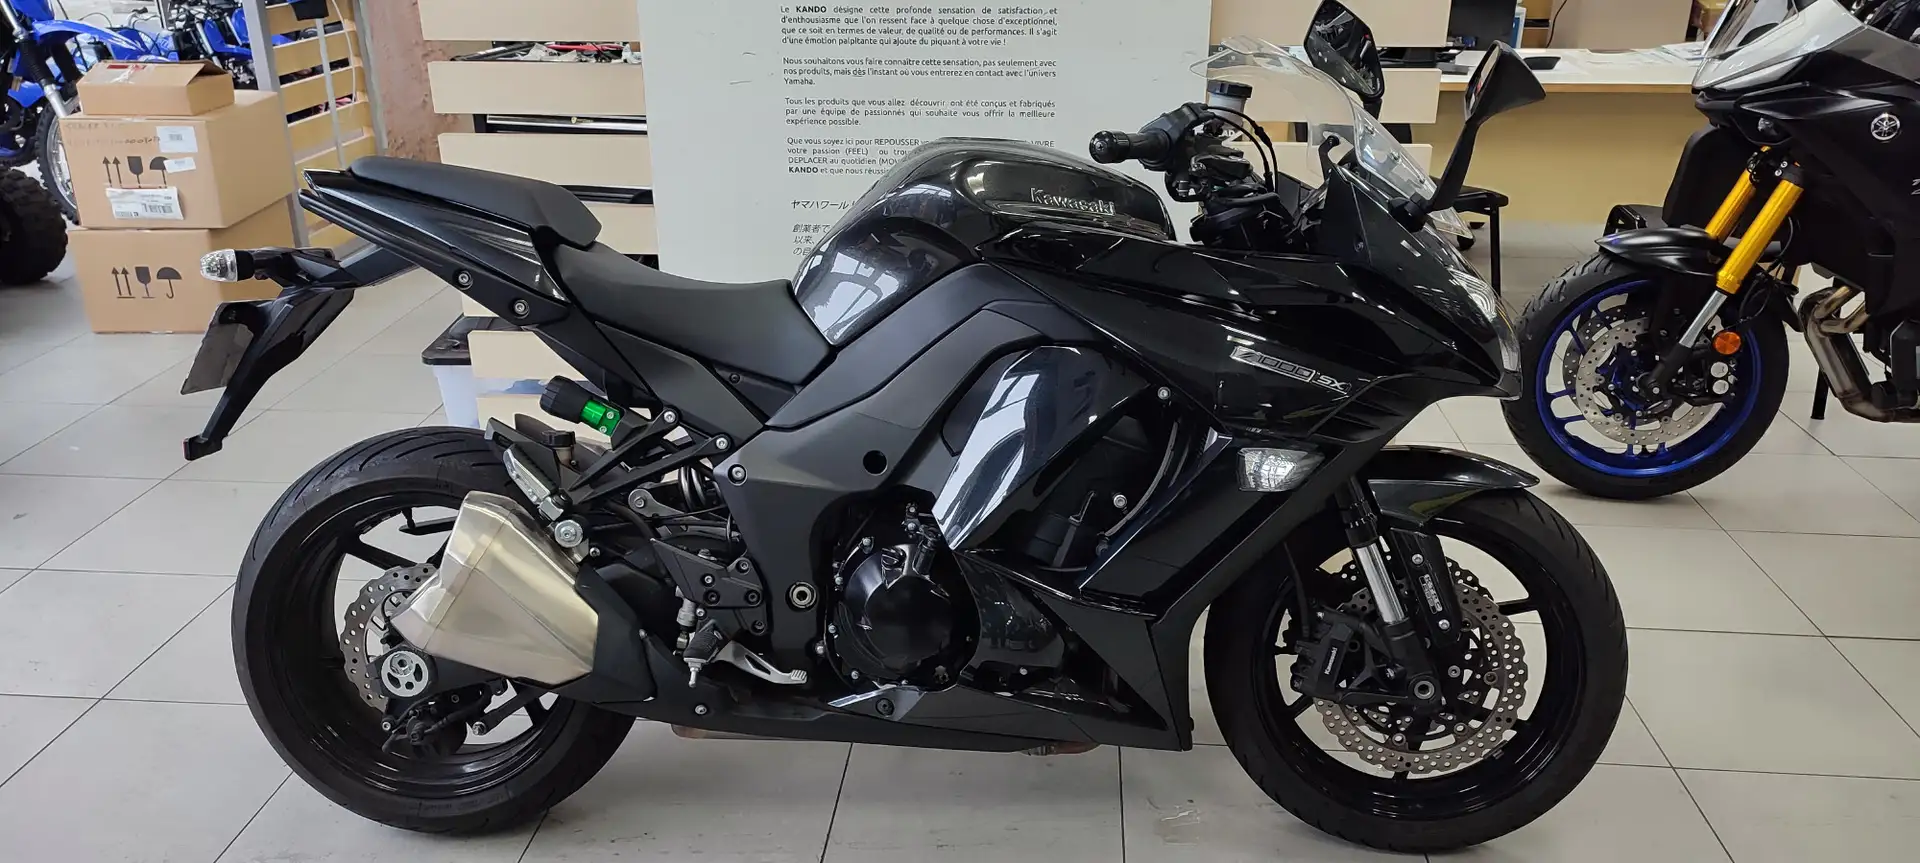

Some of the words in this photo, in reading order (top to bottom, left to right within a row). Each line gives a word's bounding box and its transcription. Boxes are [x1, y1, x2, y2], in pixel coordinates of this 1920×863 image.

[833, 5, 863, 15] désigne
[896, 5, 932, 15] profonde
[938, 16, 969, 26] quelque
[998, 17, 1057, 26] d'exceptionnel,
[878, 26, 904, 35] valeur,
[918, 26, 945, 36] qualité
[971, 27, 1027, 36] performances.
[1036, 27, 1057, 37] s'agit
[839, 36, 878, 46] palpitante
[879, 37, 891, 46] qui
[893, 37, 917, 46] ajoute
[931, 37, 960, 46] piquant
[943, 58, 982, 66] sensation,
[798, 67, 832, 76] produits,
[818, 97, 849, 106] produits
[1020, 99, 1055, 108] fabriqués
[820, 107, 846, 116] équipe
[864, 108, 905, 117] passionnés
[910, 108, 922, 117] qui
[786, 117, 827, 126] expérience
[828, 117, 861, 126] possible.
[812, 146, 840, 155] passion
[845, 146, 868, 156] (FEEL)
[841, 156, 876, 166] quotidien
[1030, 188, 1115, 216] Kawasaki
[1317, 374, 1346, 390] SX
